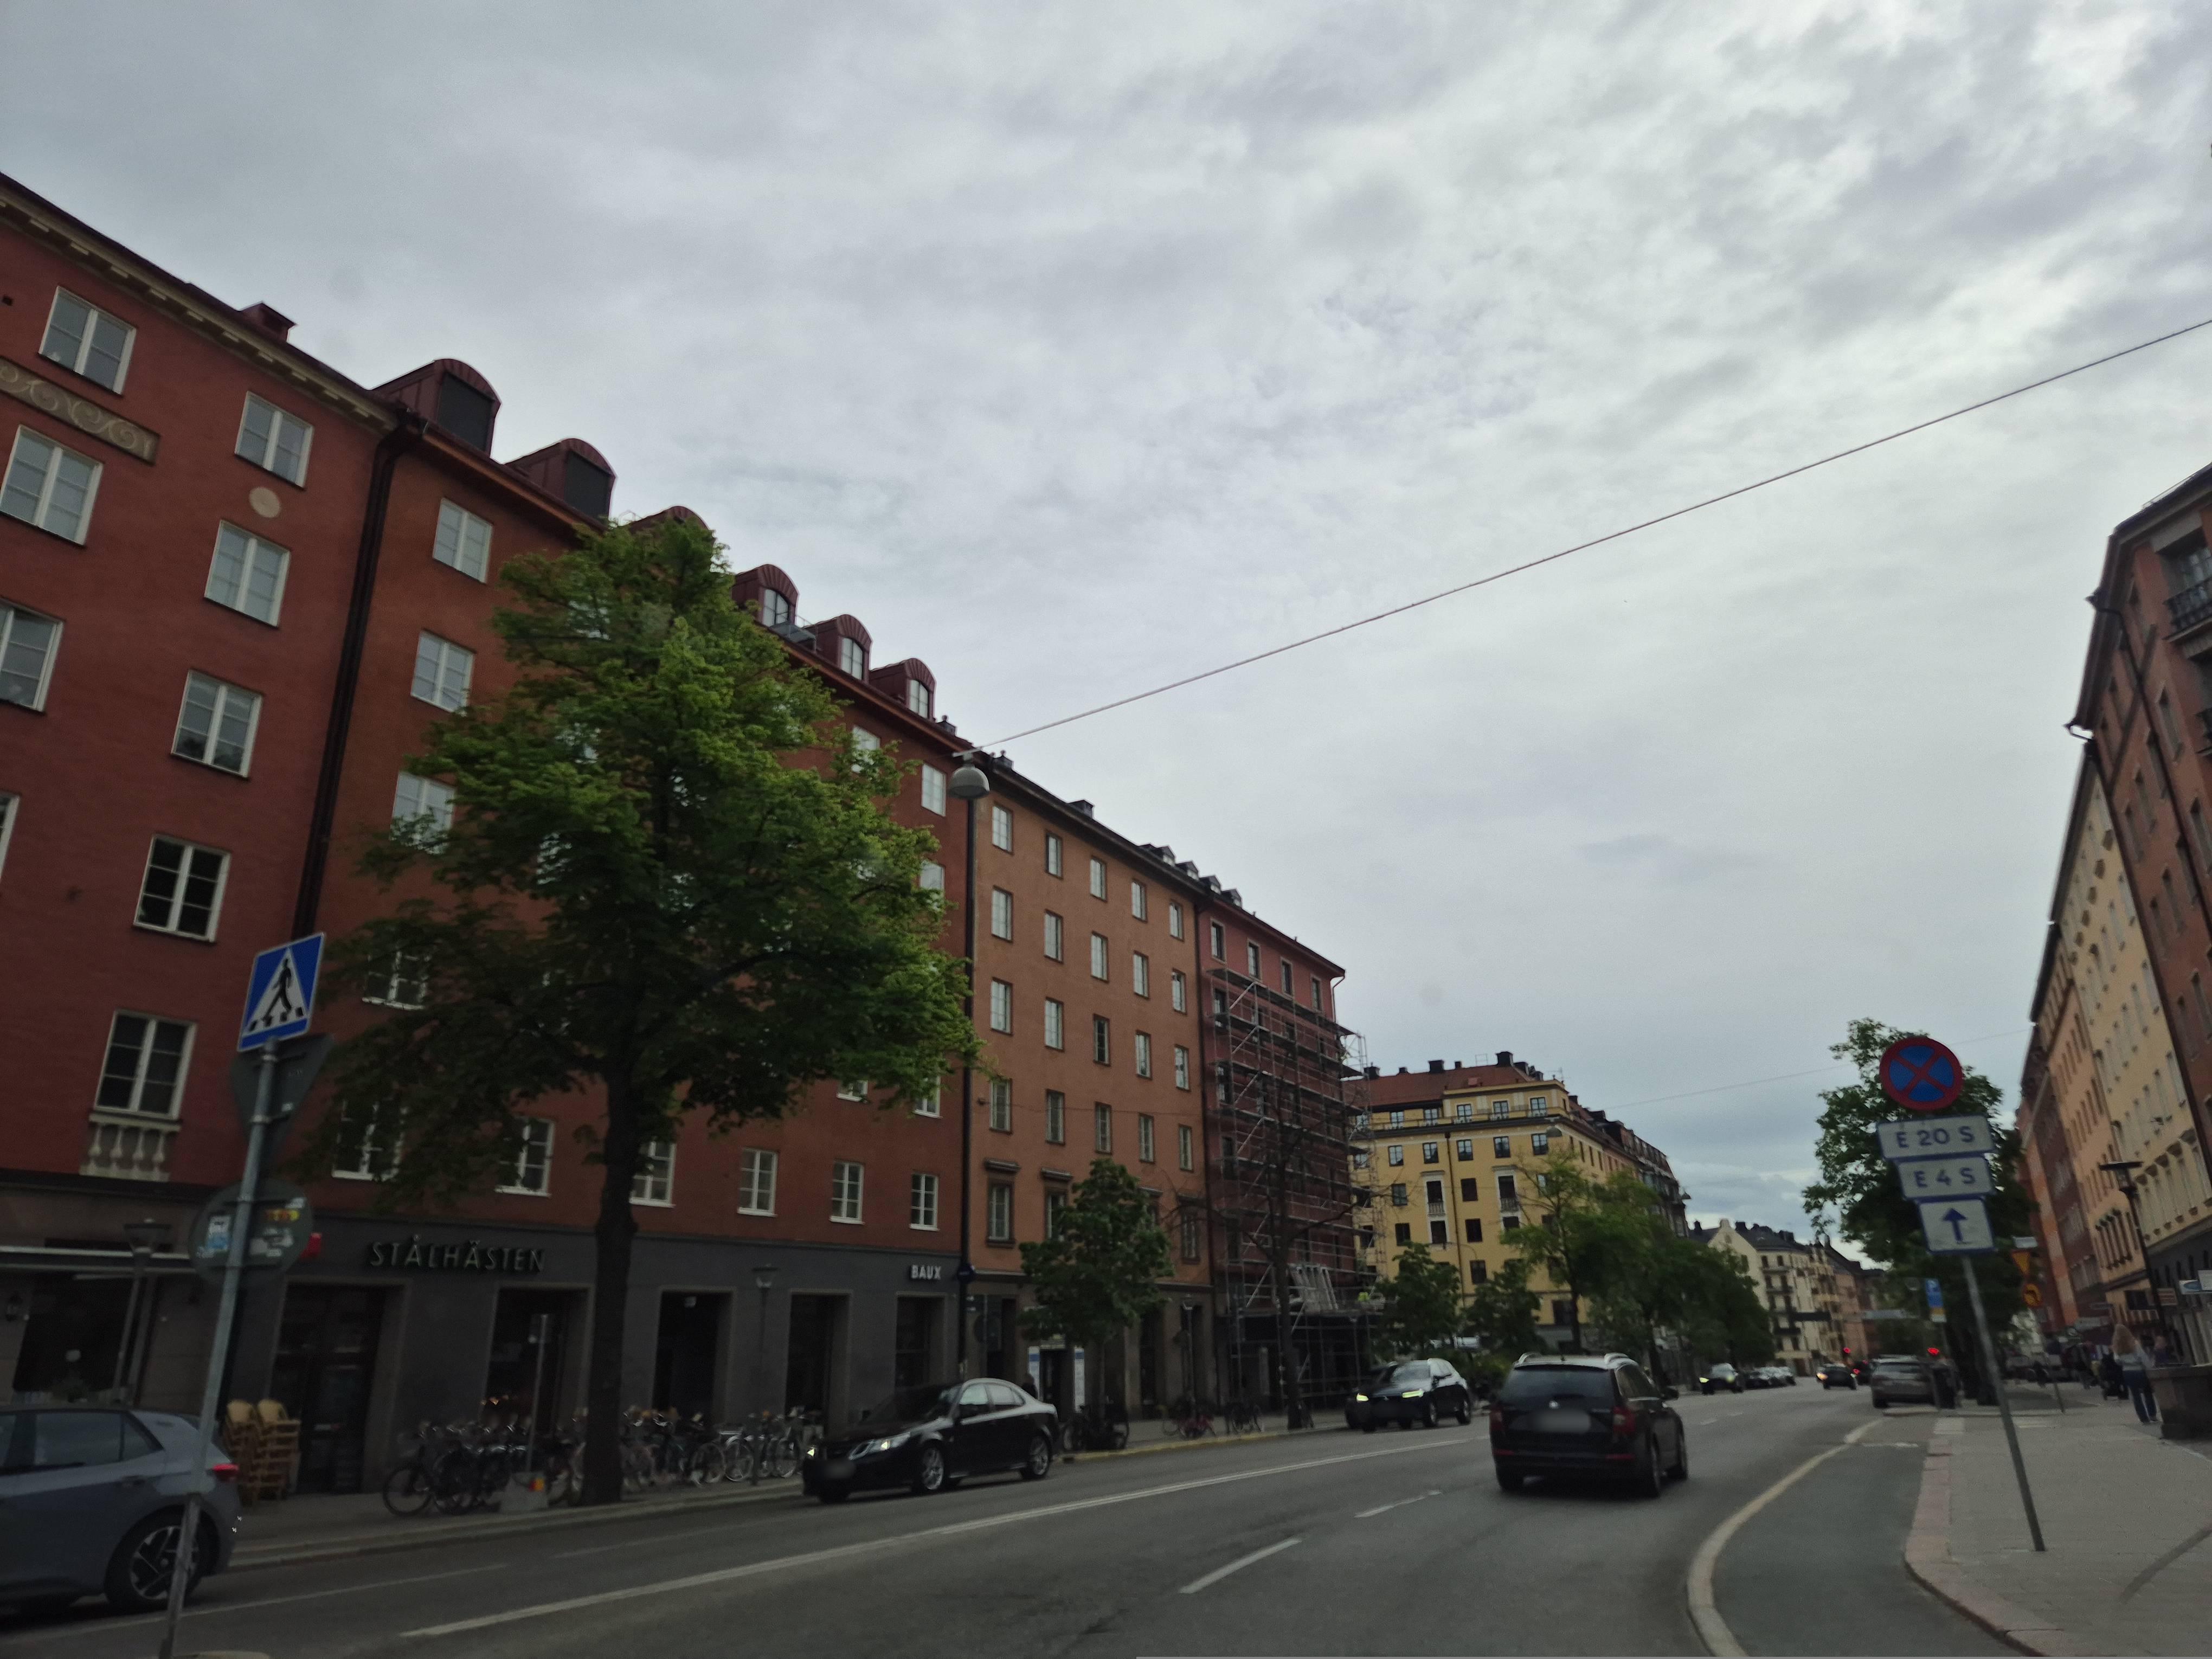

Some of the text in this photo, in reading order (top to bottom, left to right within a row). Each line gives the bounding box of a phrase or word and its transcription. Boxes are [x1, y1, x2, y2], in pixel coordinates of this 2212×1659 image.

[1896, 1126, 1974, 1148] E 20 S
[1915, 1168, 1975, 1187] E 4 S
[371, 1234, 546, 1272] STÅLHÄSTEN
[911, 1264, 942, 1280] BAUX
